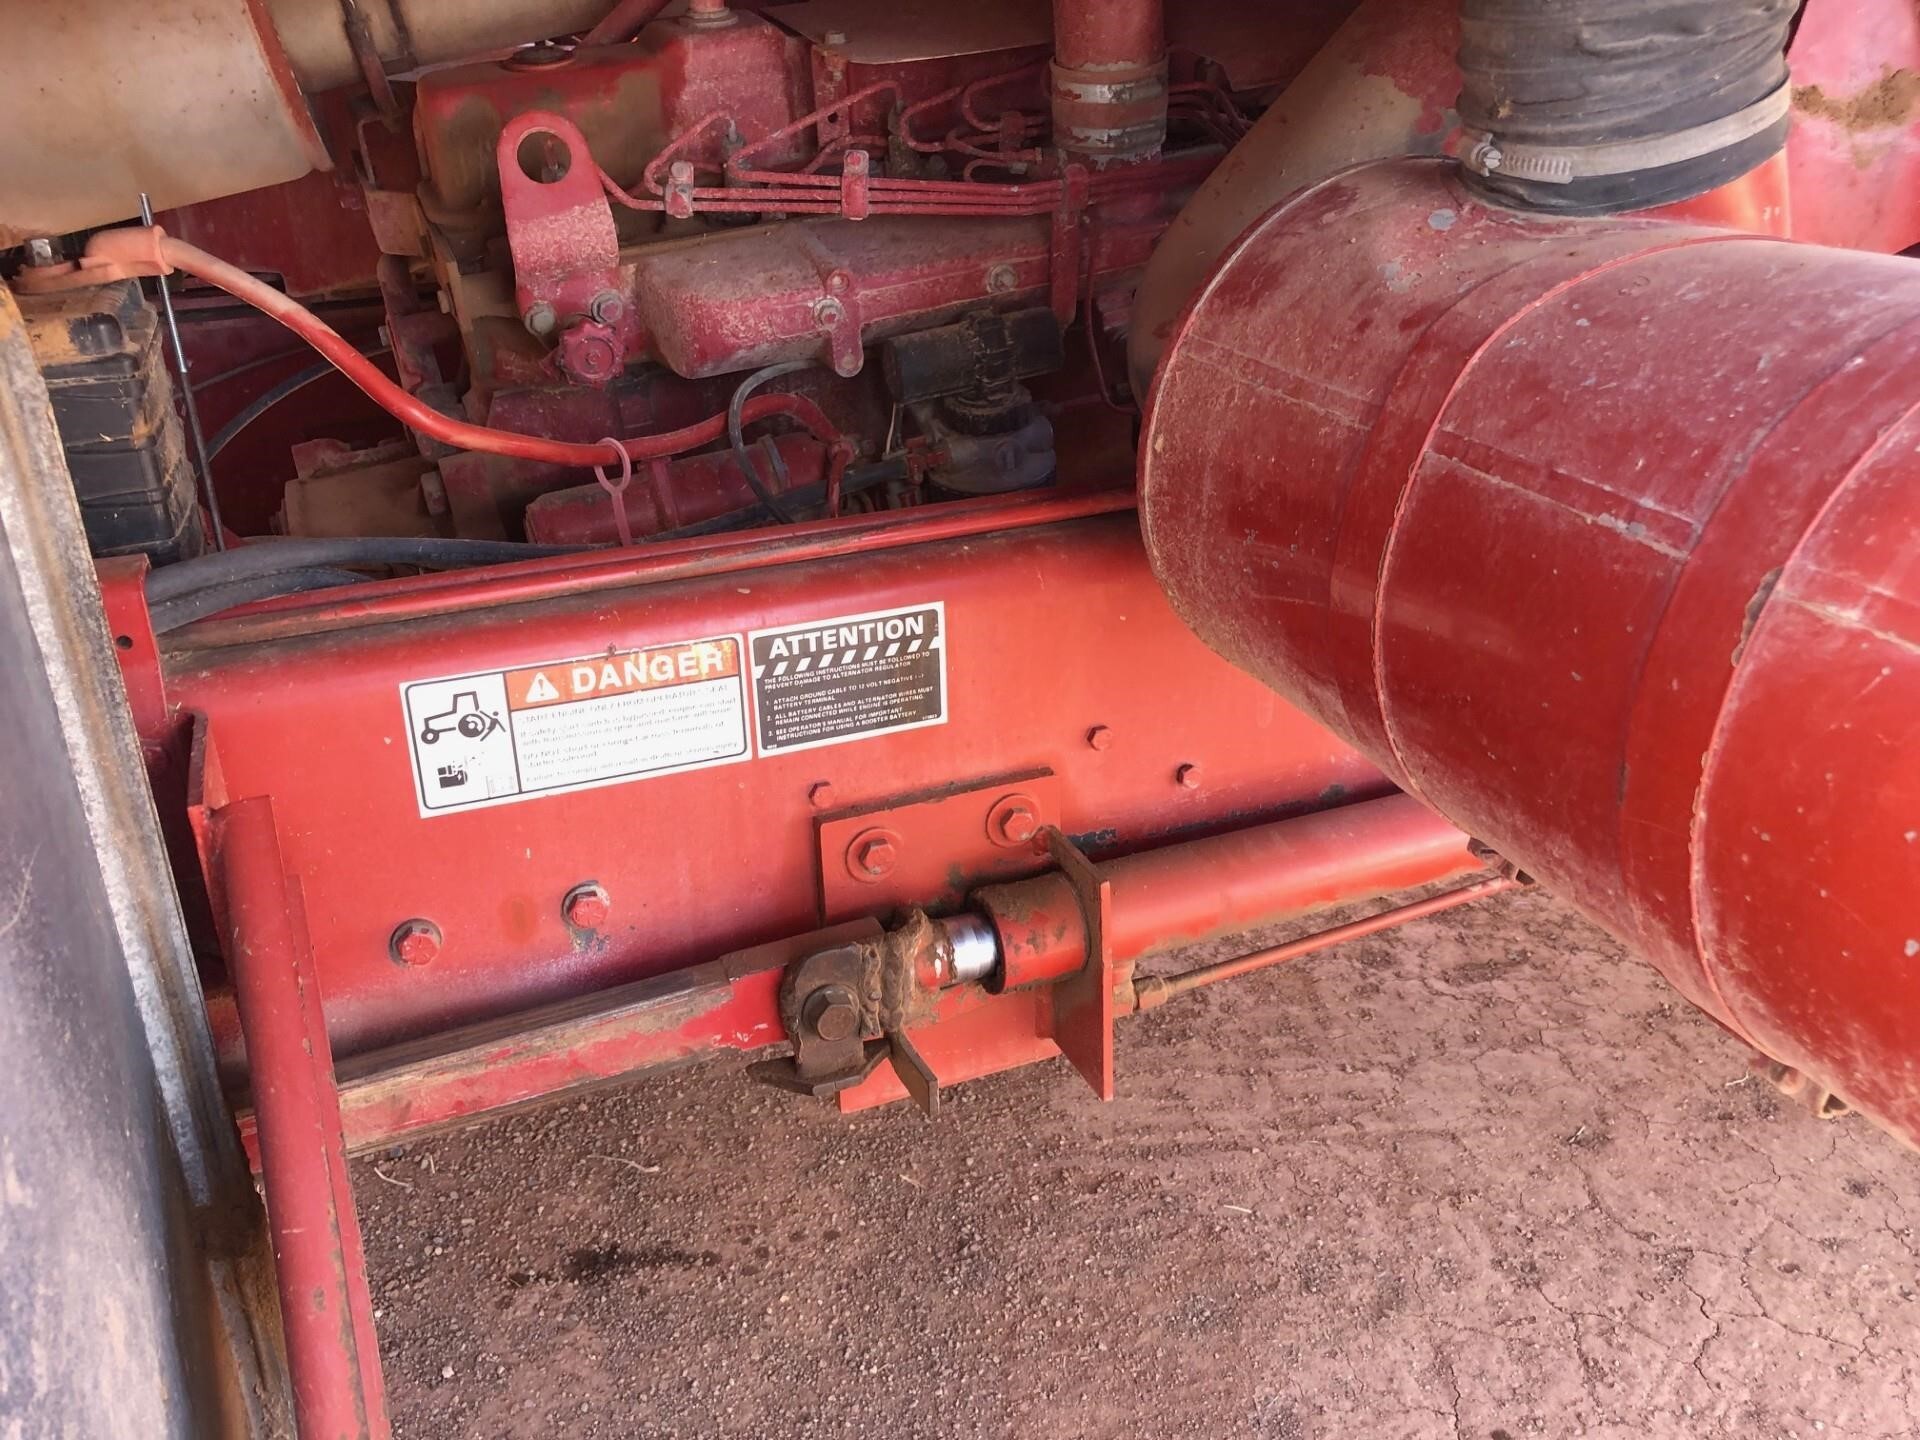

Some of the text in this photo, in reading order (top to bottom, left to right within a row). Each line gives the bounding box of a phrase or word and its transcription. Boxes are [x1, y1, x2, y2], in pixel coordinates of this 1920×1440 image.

[767, 615, 923, 659] ATTENTION
[571, 646, 723, 694] DANGER
[765, 681, 793, 690] PREVENT
[794, 676, 820, 685] DAMAGE
[832, 667, 872, 679] ALTERNATOR
[875, 661, 911, 671] REGULATOR
[778, 671, 814, 682] FOLLOWING
[816, 664, 860, 675] INSTRUCTIONS
[888, 653, 920, 663] FOLLOWED
[773, 696, 799, 704] ATTACH
[800, 691, 826, 699] GROUND
[827, 687, 846, 695] CABLE
[883, 676, 913, 685] NEGATIVE
[774, 695, 835, 711] BATTERY TERMINAL
[776, 717, 799, 725] REMAIN
[801, 710, 837, 721] CONNECTED
[839, 706, 857, 714] WHILE
[859, 702, 880, 710] ENGINE
[788, 708, 816, 717] BATTERY
[818, 703, 841, 712] CABLES
[857, 693, 897, 705] ALTERNATOR
[827, 716, 853, 725] MANUAL
[868, 707, 902, 718] IMPORTANT
[777, 728, 821, 741] INSTRUCTIONS
[836, 722, 854, 730] USING
[862, 716, 888, 725] BOOSTER
[889, 710, 916, 720] BATTERY
